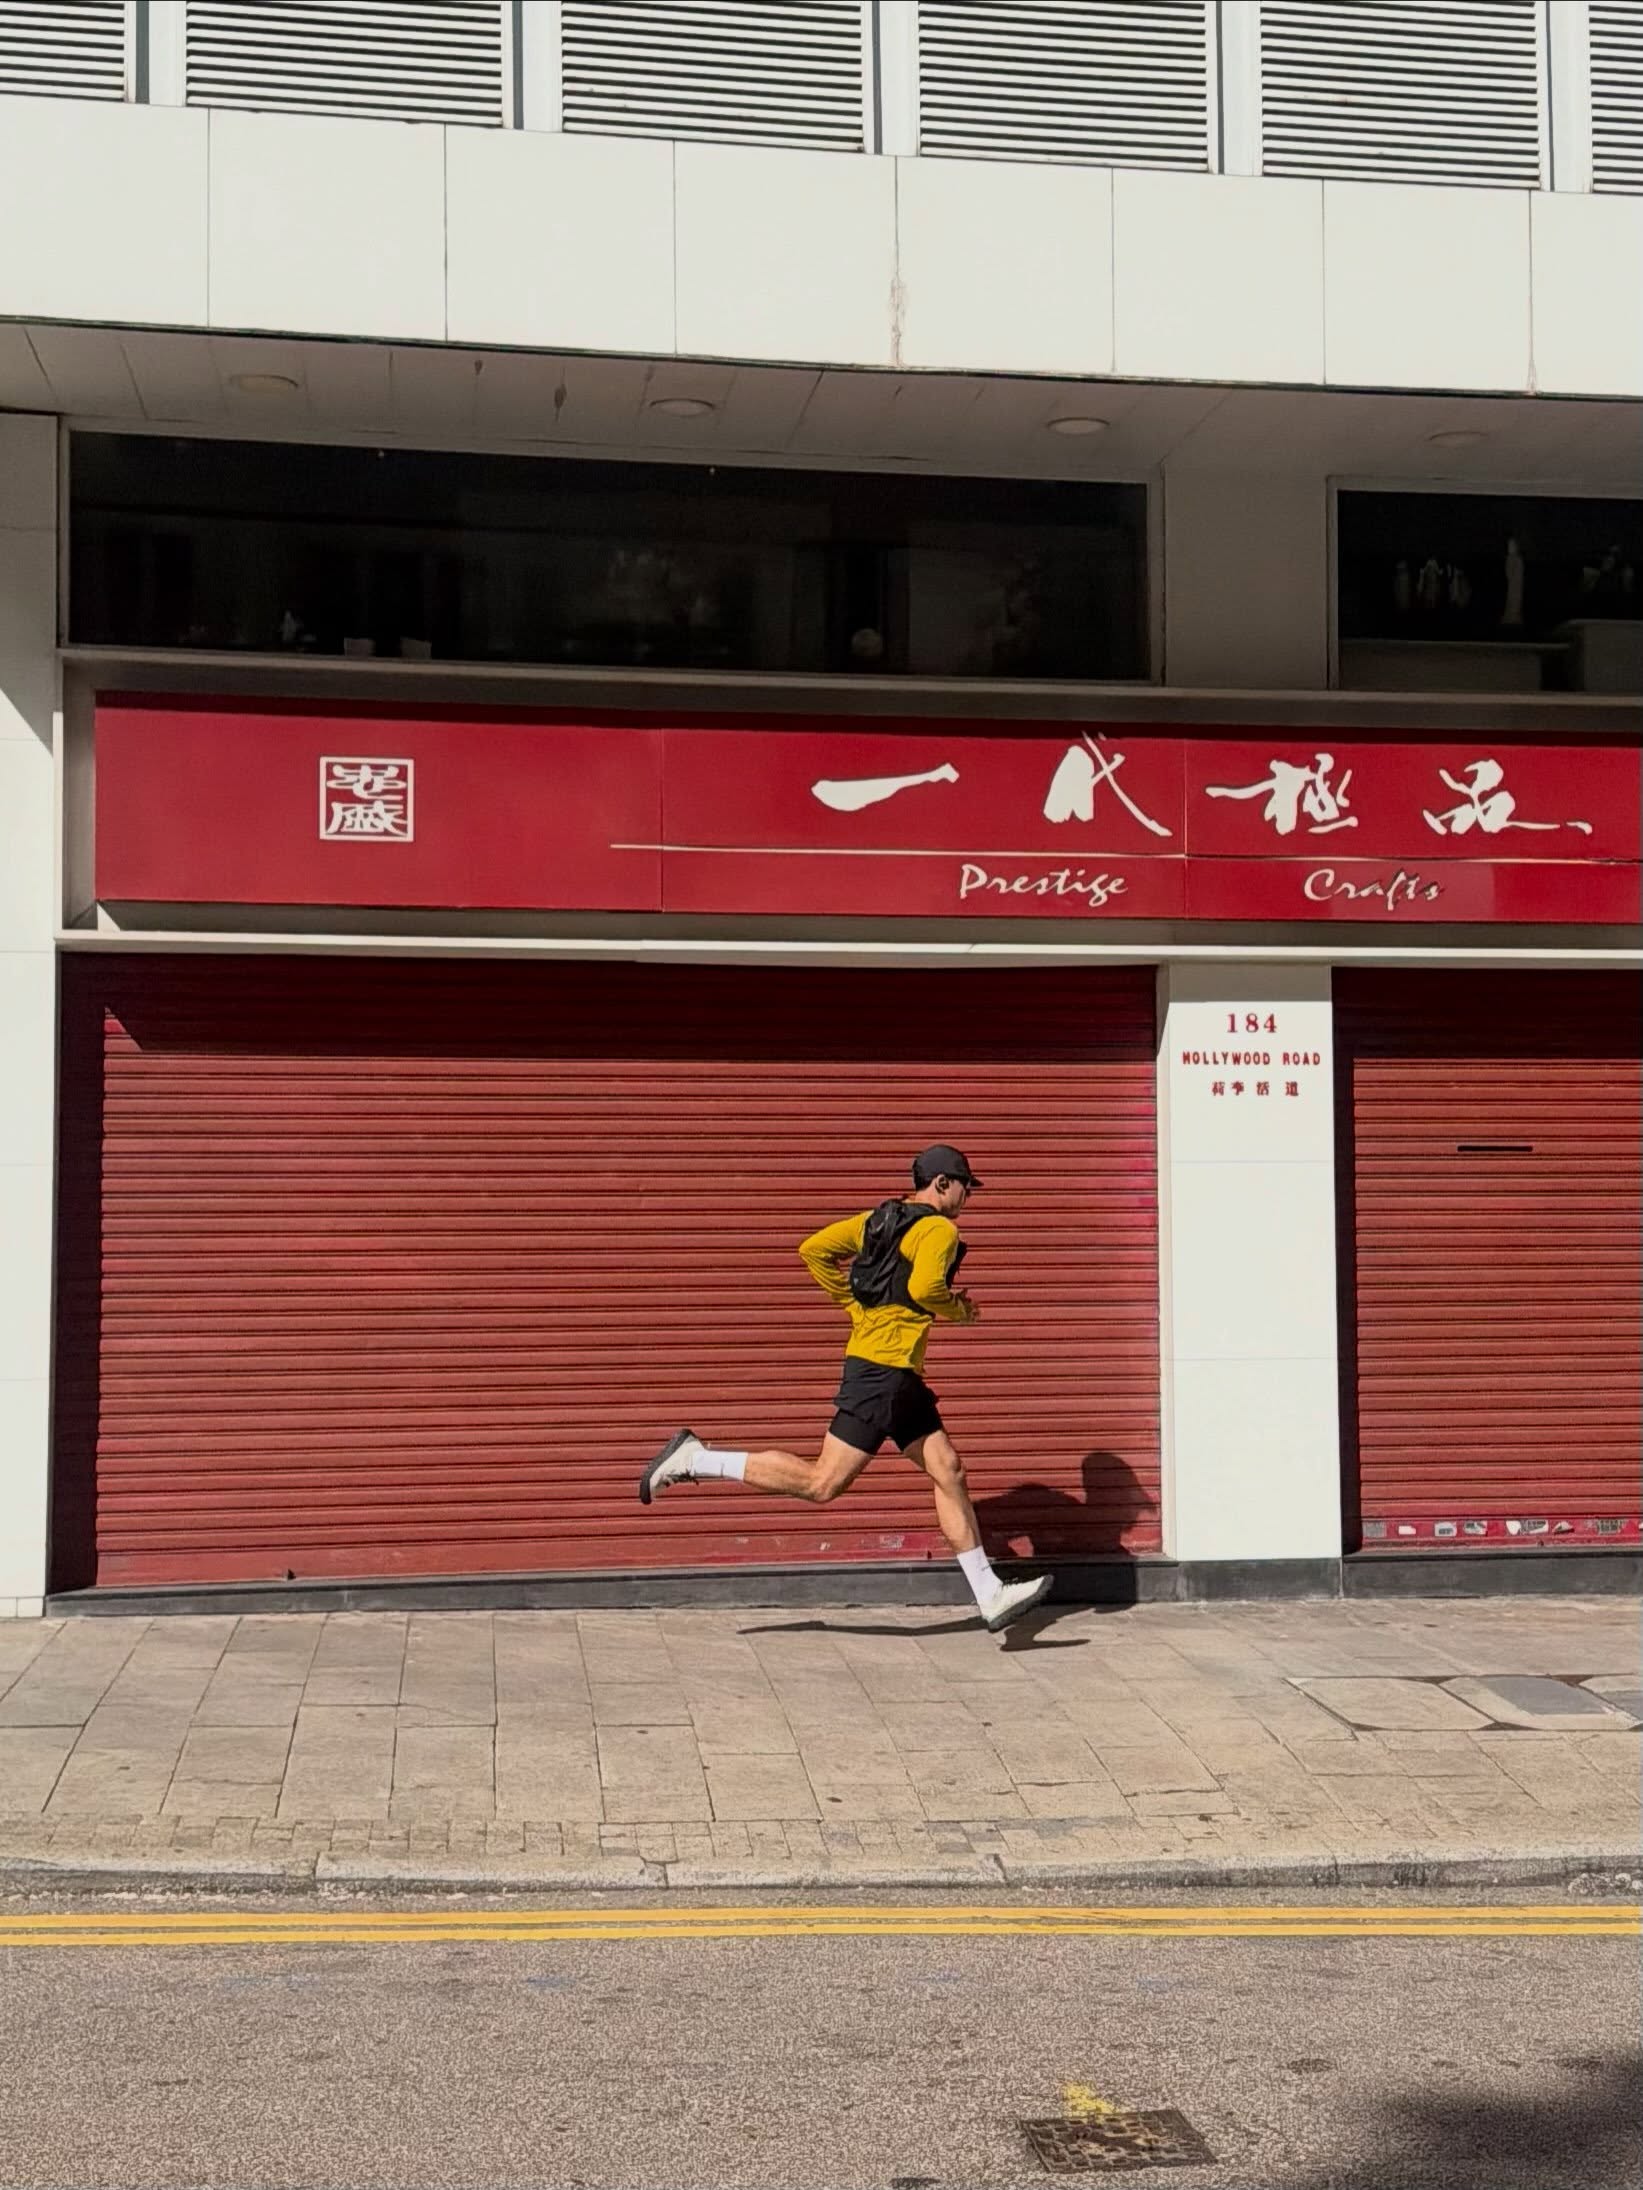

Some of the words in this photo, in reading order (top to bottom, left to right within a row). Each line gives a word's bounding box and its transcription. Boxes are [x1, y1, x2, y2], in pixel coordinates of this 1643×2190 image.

[959, 863, 1128, 907] Prestige
[1303, 867, 1440, 911] Crafts
[1227, 1013, 1277, 1033] 184
[1182, 1051, 1271, 1065] HOLLYWOOD
[1282, 1052, 1321, 1066] ROAD
